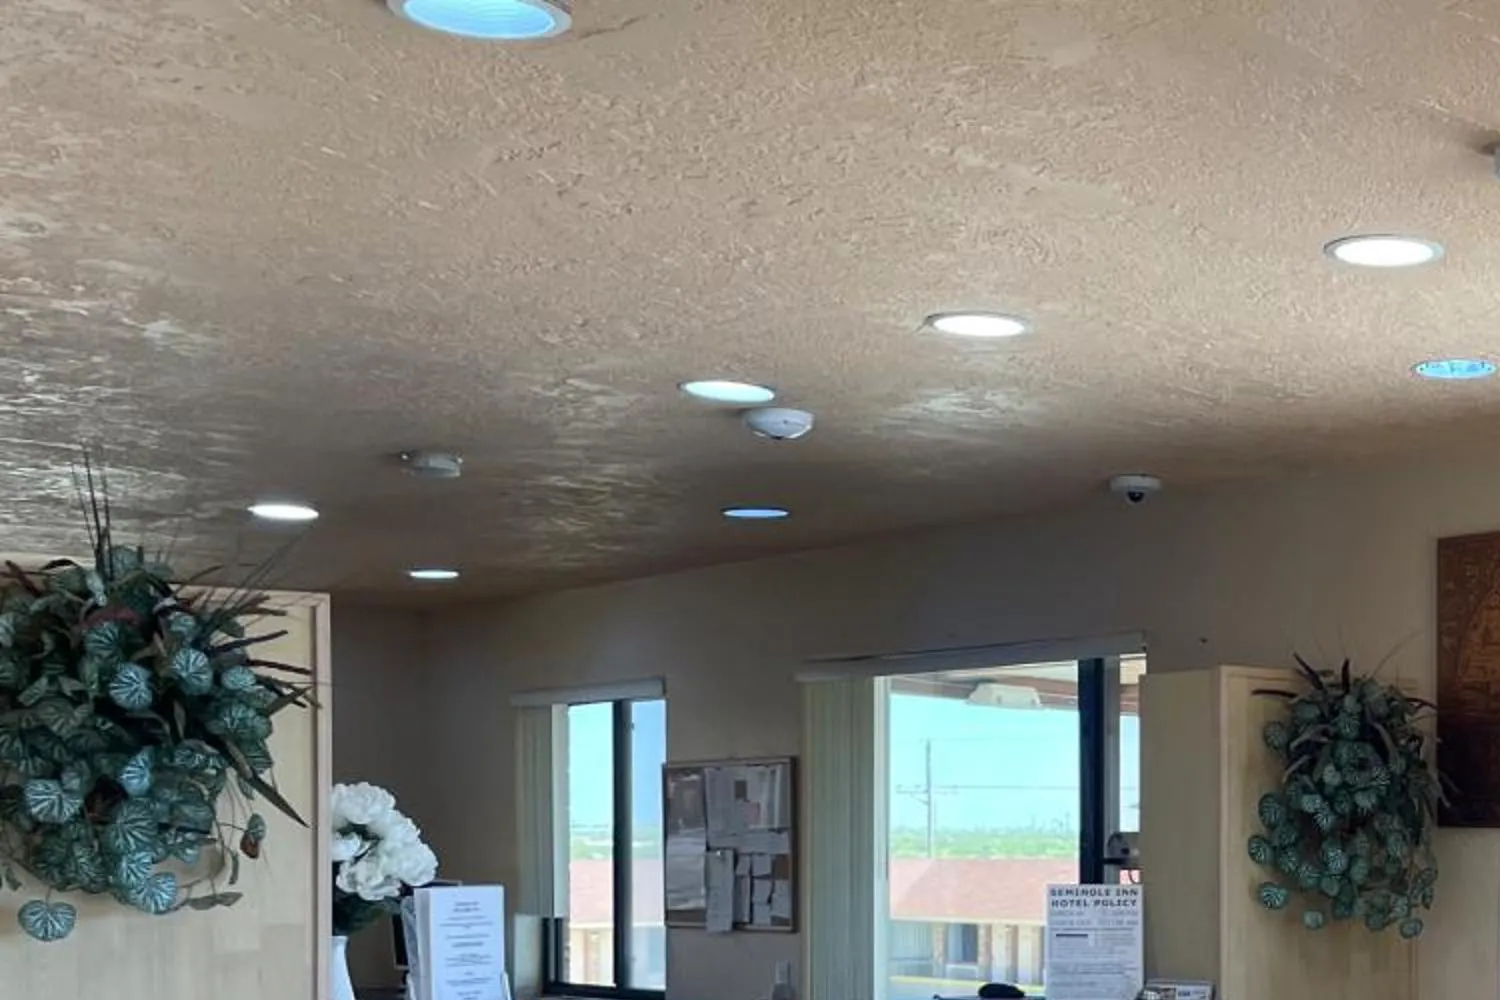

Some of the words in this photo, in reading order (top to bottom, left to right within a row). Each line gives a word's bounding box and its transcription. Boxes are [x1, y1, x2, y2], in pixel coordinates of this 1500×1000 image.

[1050, 887, 1110, 897] SEMINOLE
[1115, 887, 1138, 897] INN
[1051, 899, 1091, 908] HOTEL
[1094, 899, 1137, 908] POLICY
